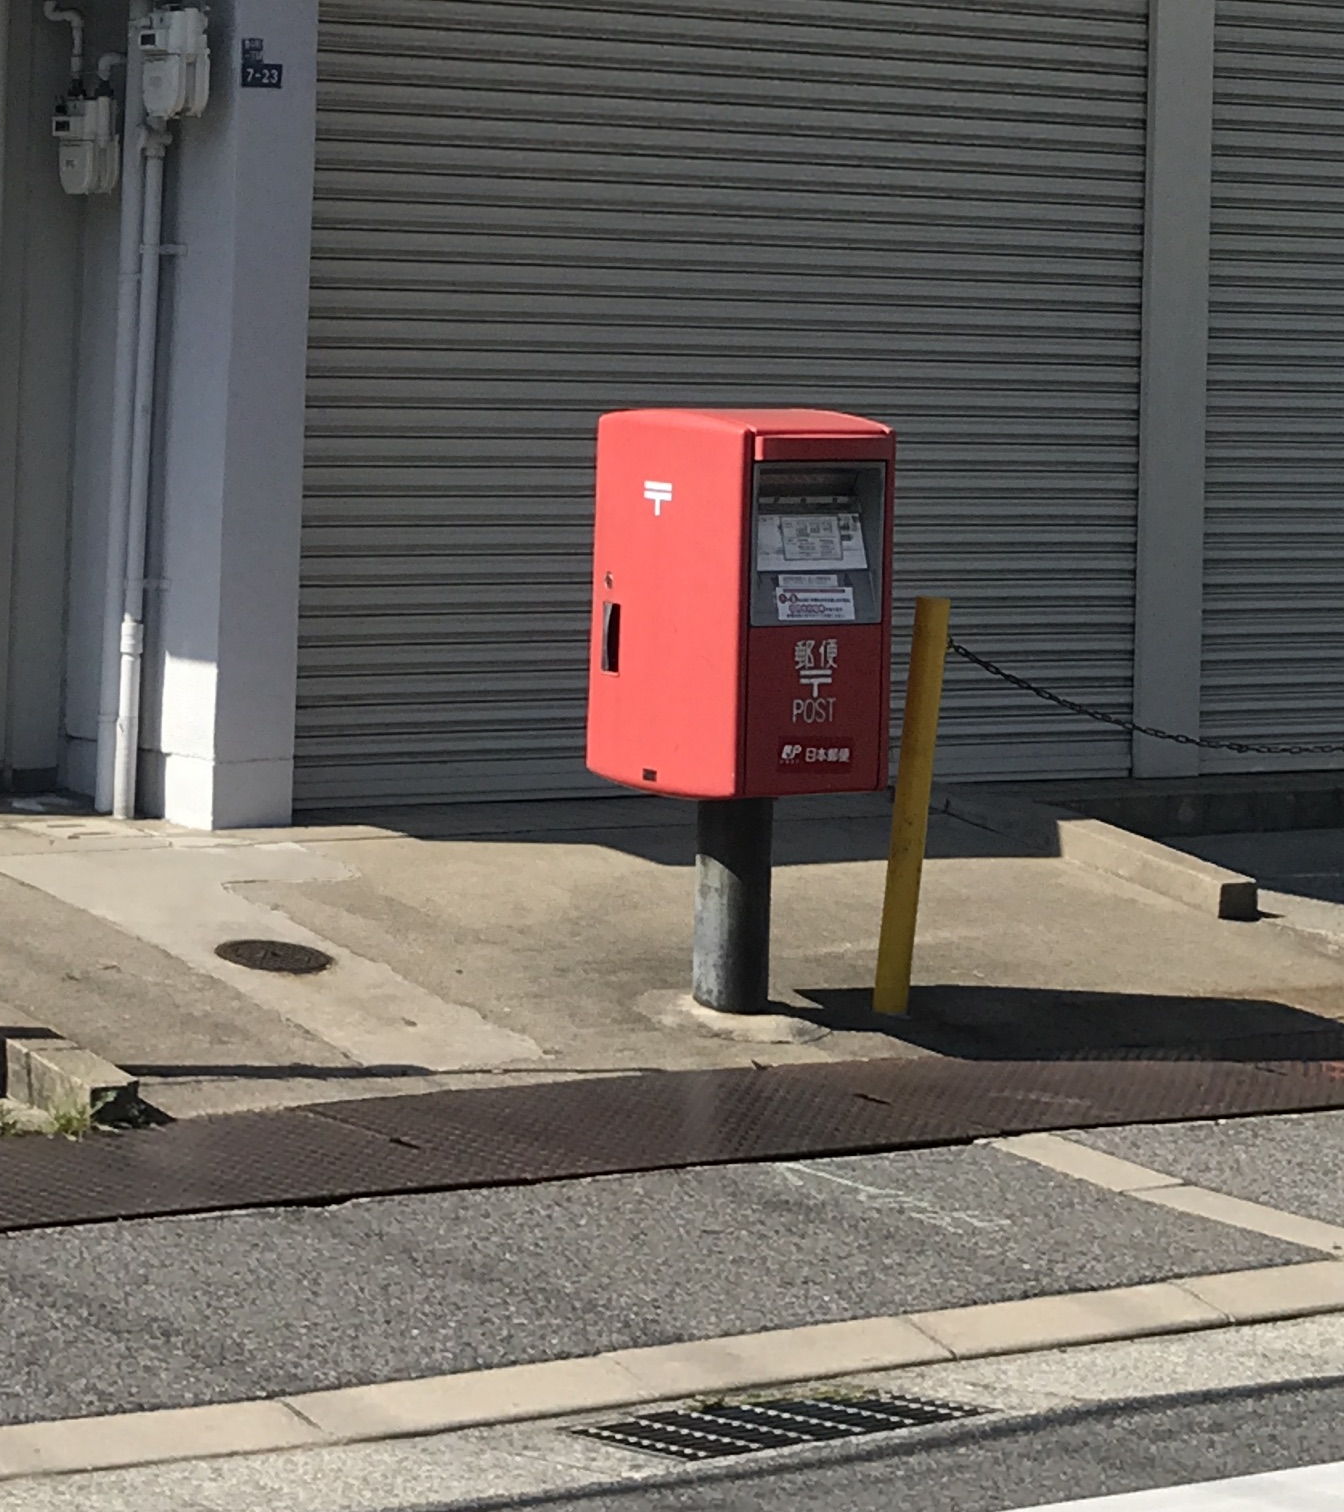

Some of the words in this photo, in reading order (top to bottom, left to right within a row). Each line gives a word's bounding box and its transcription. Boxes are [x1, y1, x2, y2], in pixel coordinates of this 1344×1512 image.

[246, 68, 279, 84] 7-23
[794, 639, 838, 670] 郵便
[792, 697, 837, 724] POST
[804, 747, 850, 763] 日本郵便
